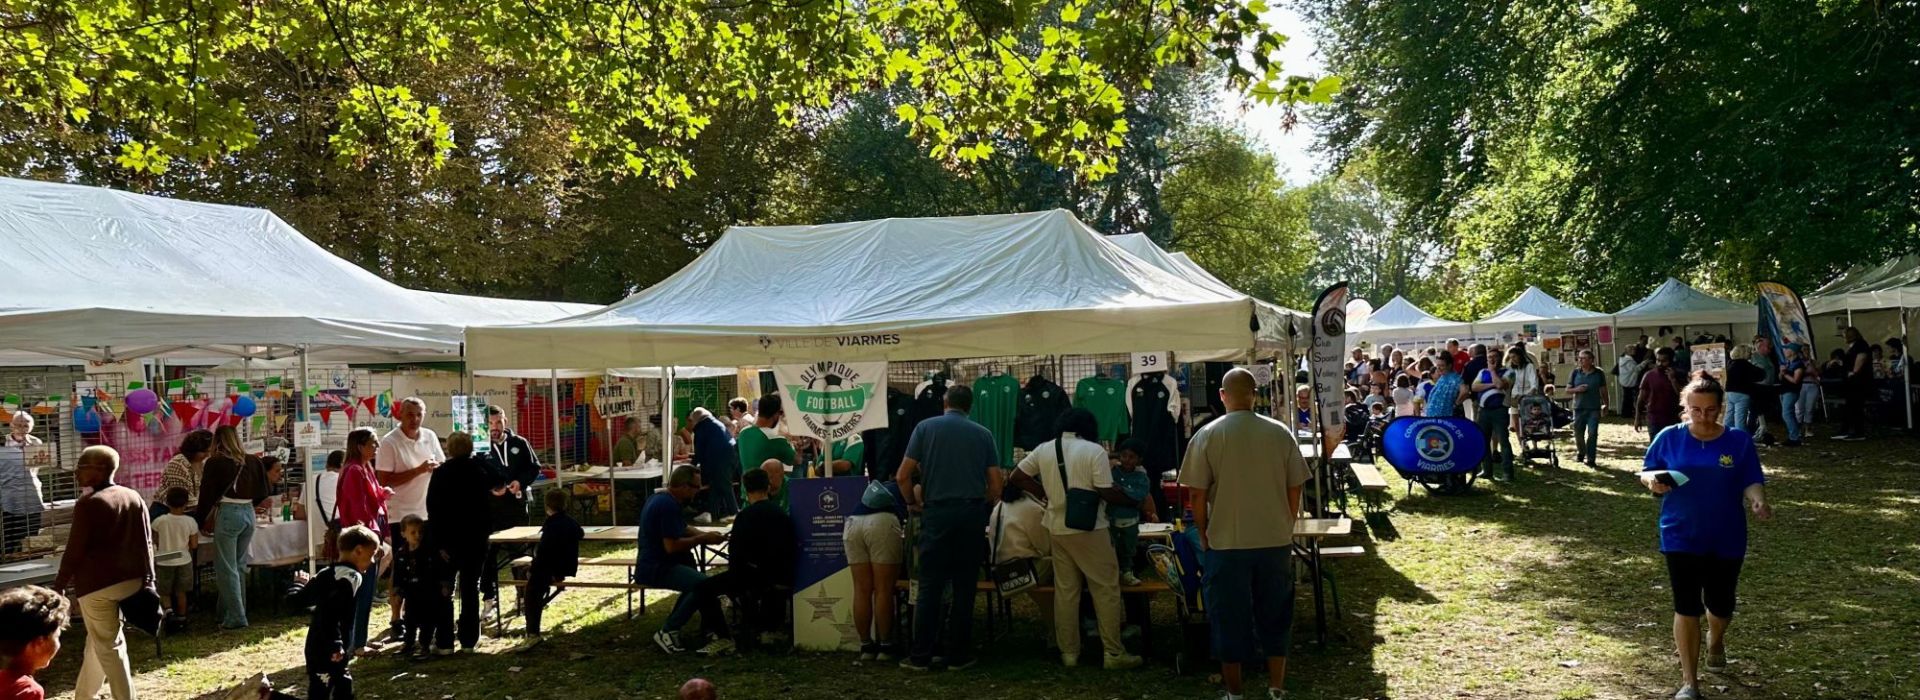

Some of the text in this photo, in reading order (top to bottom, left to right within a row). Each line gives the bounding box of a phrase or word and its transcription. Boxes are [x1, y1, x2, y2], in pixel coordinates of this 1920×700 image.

[777, 333, 901, 348] VILLE DE VIARMES
[1141, 354, 1157, 367] 39
[800, 361, 860, 384] OLYMPIQUE
[806, 395, 857, 410] FOOTBALL
[1417, 459, 1456, 472] VIARMES
